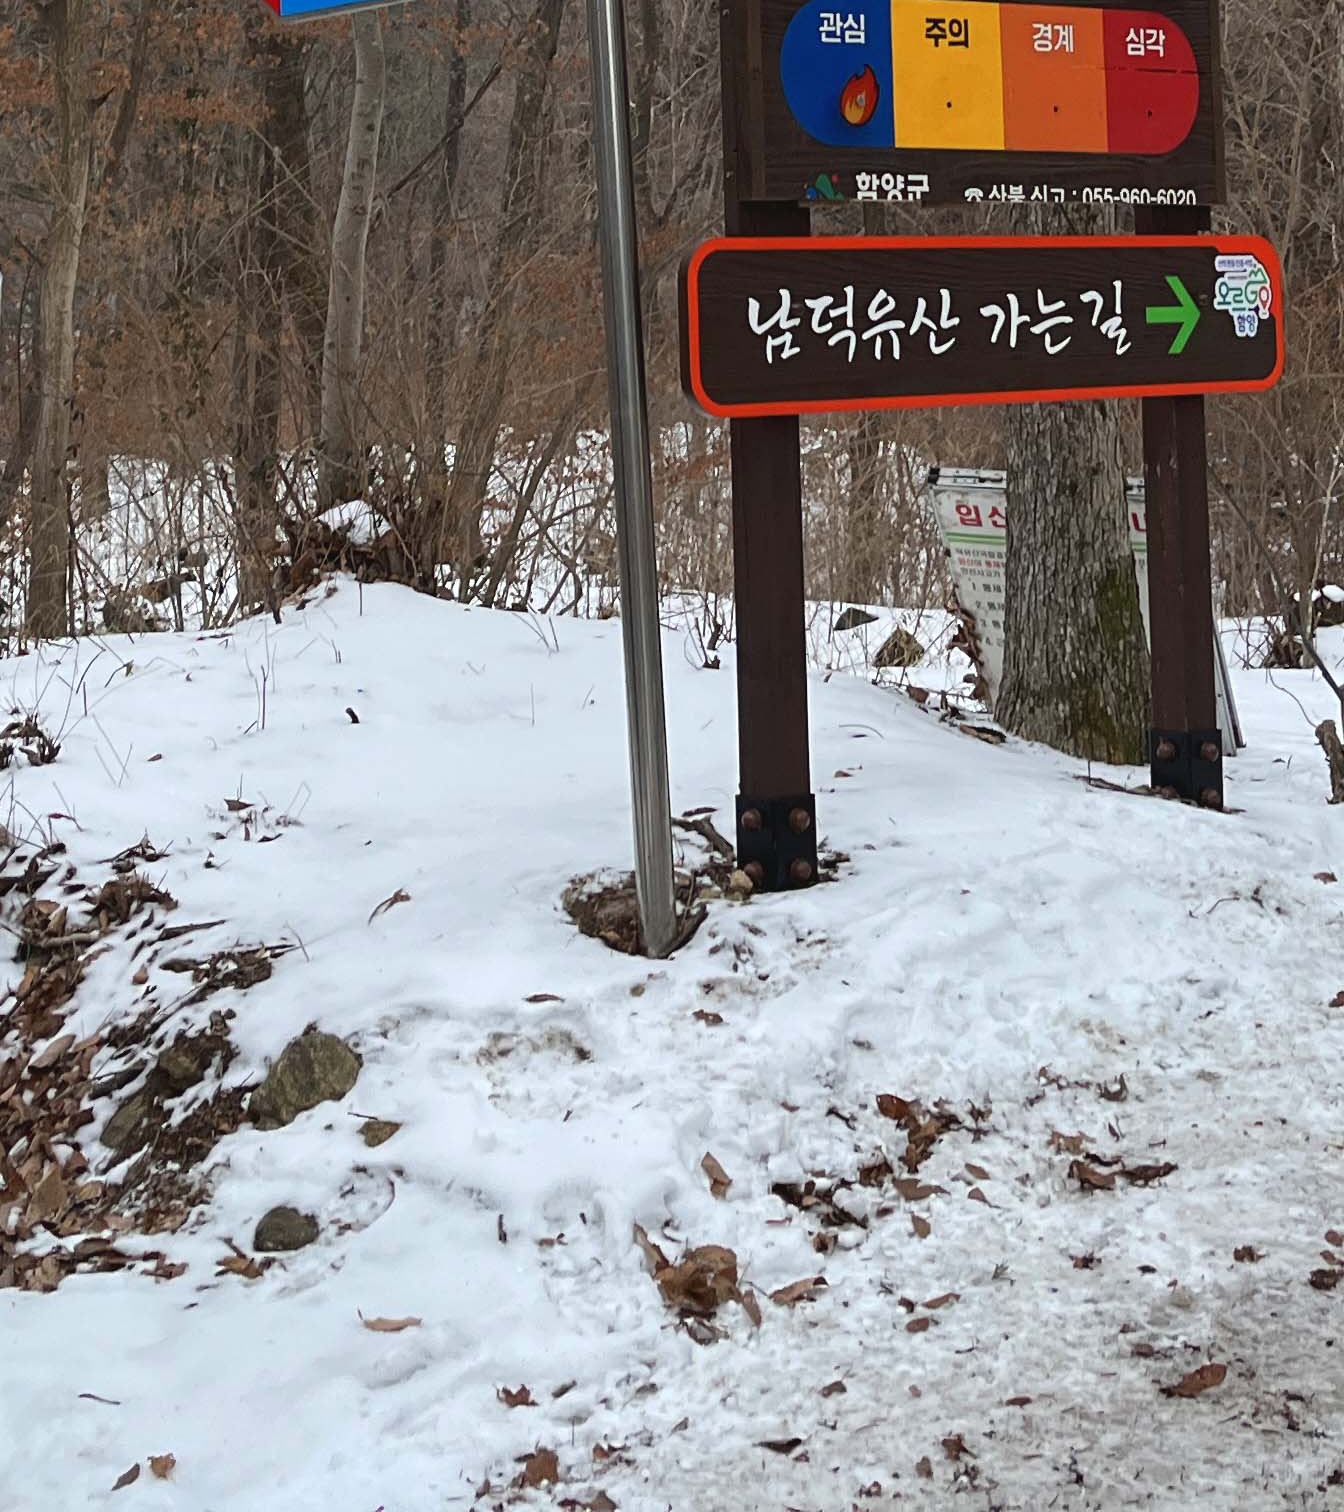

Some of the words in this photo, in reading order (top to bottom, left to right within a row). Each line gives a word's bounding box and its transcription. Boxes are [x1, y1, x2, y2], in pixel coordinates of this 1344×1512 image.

[819, 11, 866, 45] 관심
[924, 17, 970, 49] 주의
[1032, 23, 1075, 54] 경계
[1125, 27, 1166, 58] 심각
[747, 285, 960, 364] 남덕유산
[1237, 314, 1256, 332] 함양
